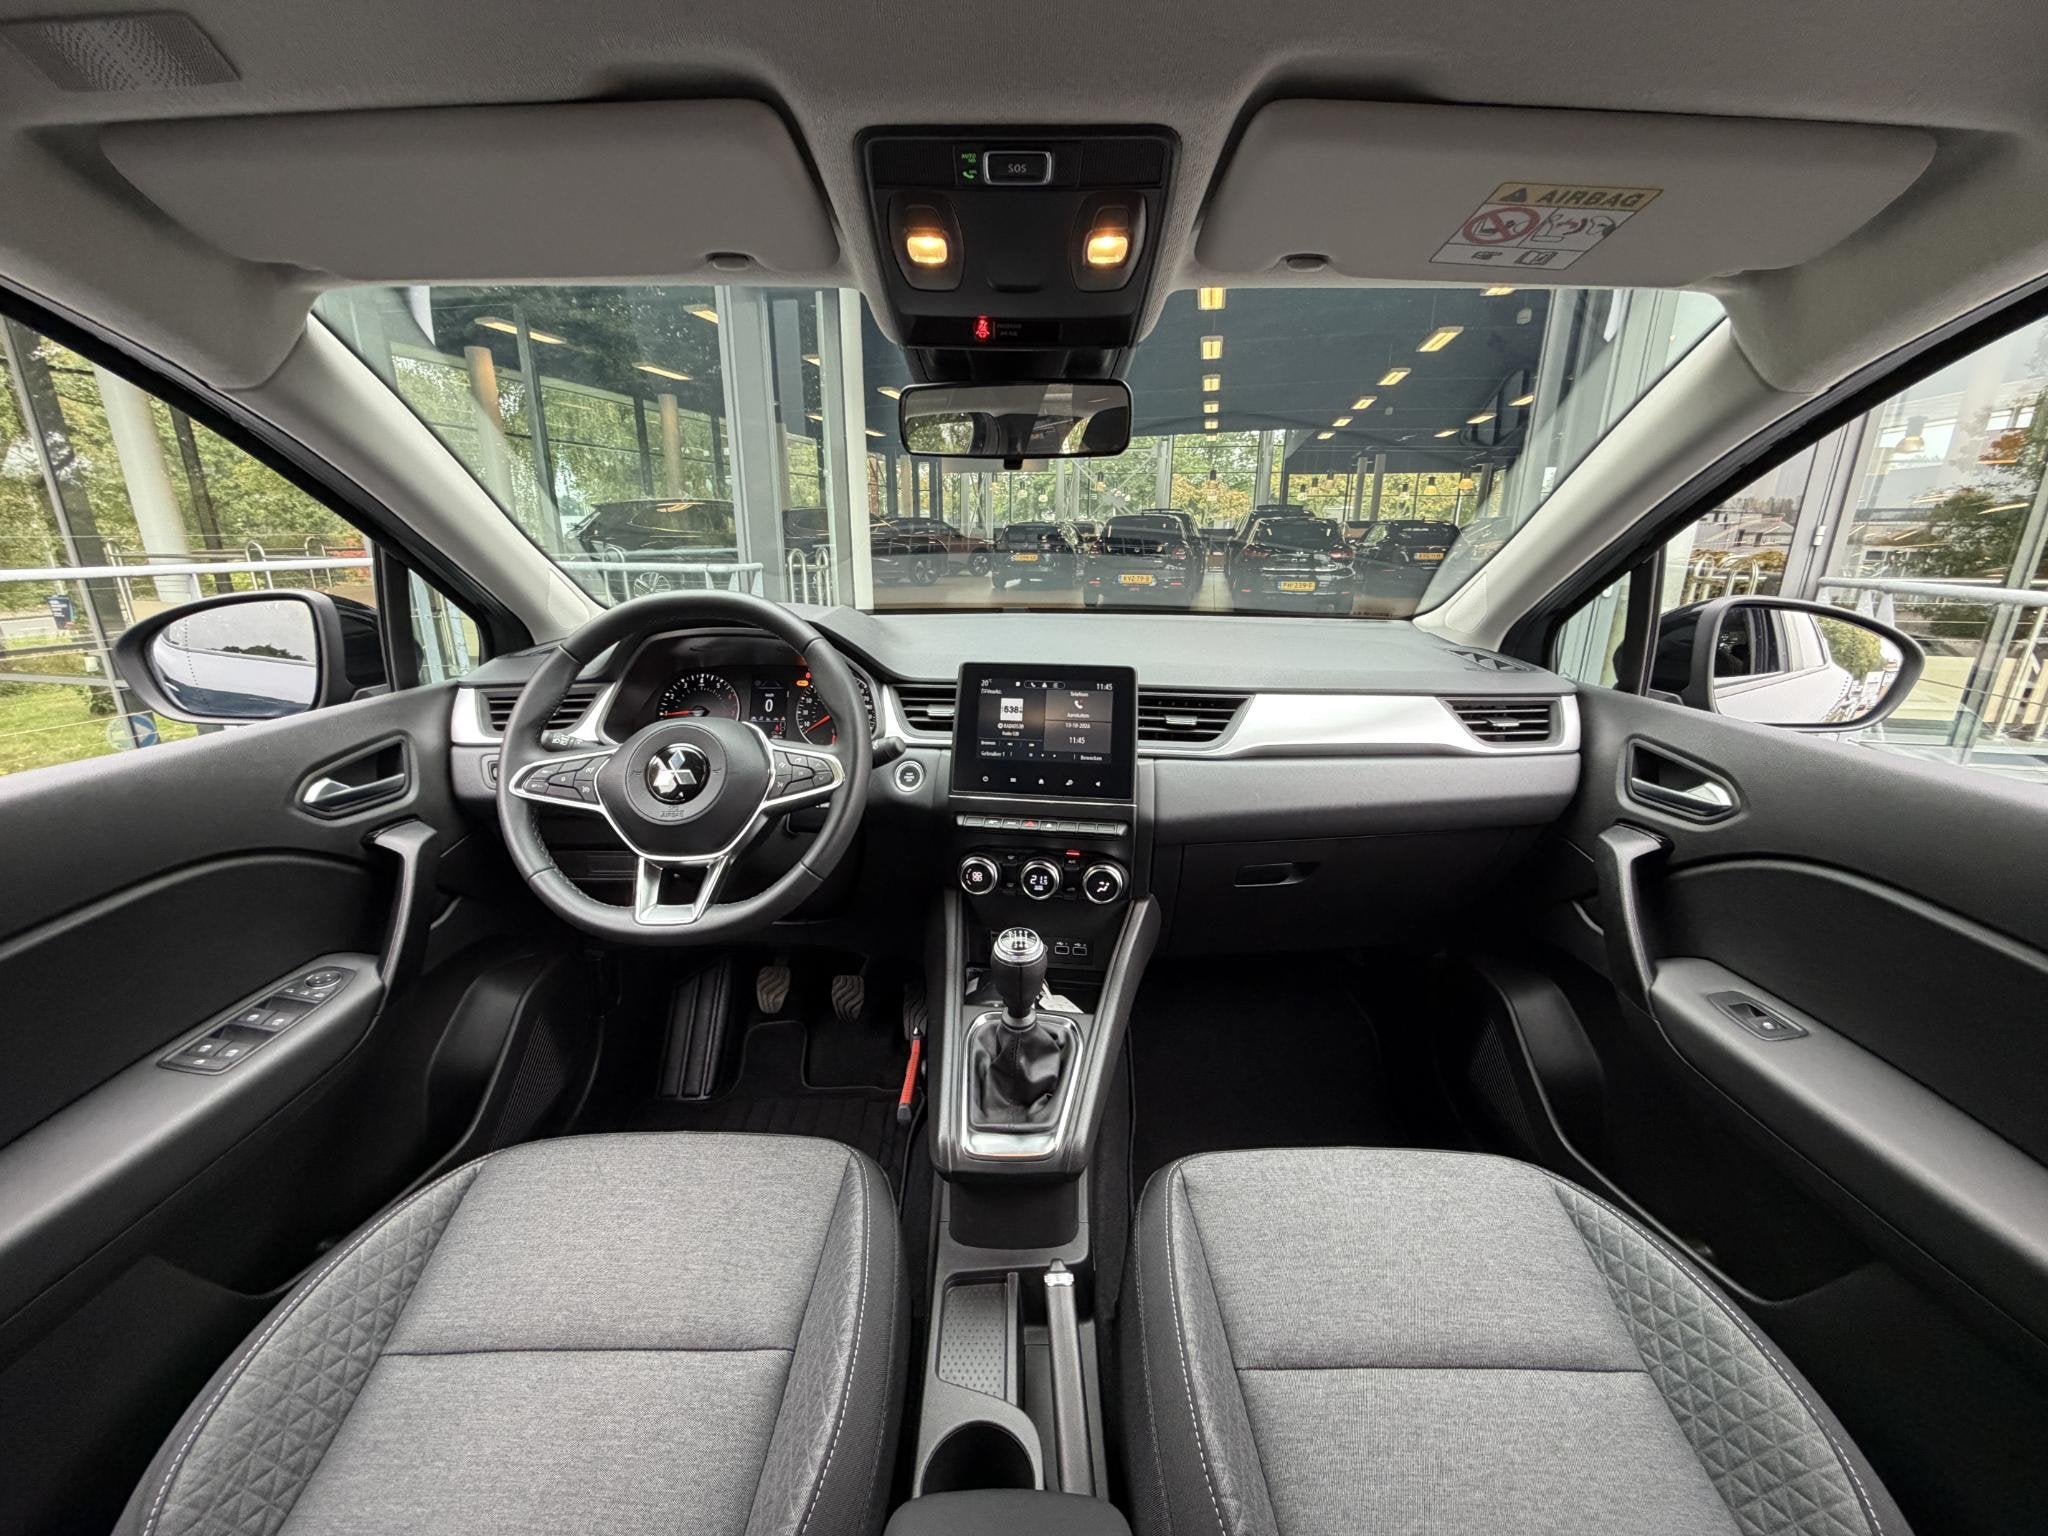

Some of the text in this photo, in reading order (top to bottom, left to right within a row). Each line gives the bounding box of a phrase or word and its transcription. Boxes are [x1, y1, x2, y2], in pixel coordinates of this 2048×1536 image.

[1008, 163, 1027, 173] SOS
[1535, 188, 1643, 207] AIRBAG
[765, 699, 773, 712] 0
[1069, 736, 1086, 744] 11:45
